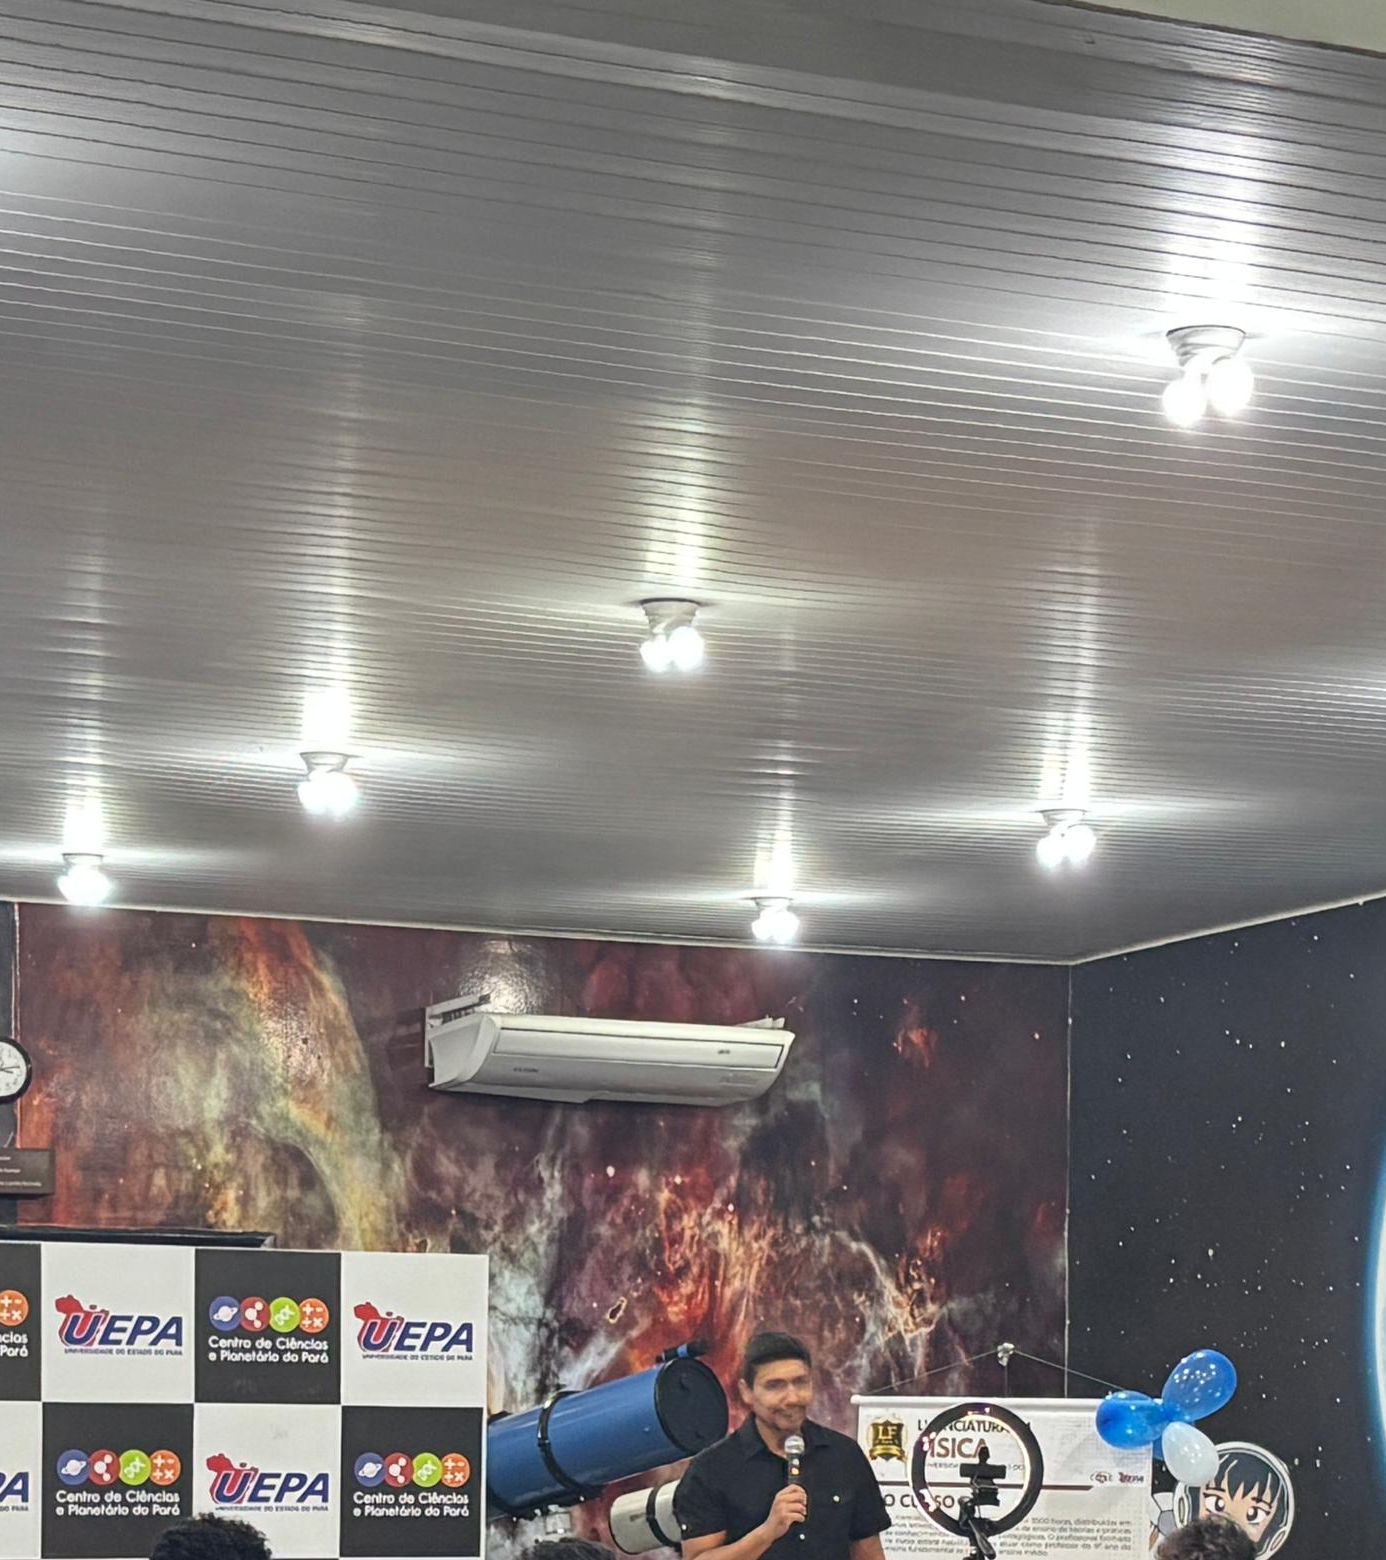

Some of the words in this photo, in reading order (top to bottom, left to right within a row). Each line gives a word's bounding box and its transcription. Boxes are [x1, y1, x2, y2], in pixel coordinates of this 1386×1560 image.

[65, 1312, 183, 1346] UEPA
[360, 1319, 473, 1352] UEPA
[208, 1336, 251, 1350] Centro
[256, 1337, 272, 1350] de
[276, 1337, 328, 1351] Ciências
[0, 1346, 29, 1357] Pará
[209, 1353, 216, 1361] e
[220, 1350, 277, 1364] Planetário
[281, 1351, 297, 1363] do
[301, 1352, 329, 1363] Pará
[216, 1472, 330, 1504] UEPA
[56, 1491, 99, 1503] Centro
[105, 1491, 121, 1503] de
[126, 1490, 180, 1504] Ciências
[354, 1492, 394, 1504] Centro
[399, 1492, 415, 1504] de
[420, 1492, 469, 1506] Ciências
[56, 1507, 64, 1516] e
[68, 1503, 128, 1517] Planetário
[133, 1505, 150, 1517] do
[154, 1505, 181, 1516] Pará
[354, 1509, 361, 1517] e
[364, 1505, 420, 1518] Planetário
[425, 1506, 440, 1518] do
[444, 1506, 469, 1518] Pará
